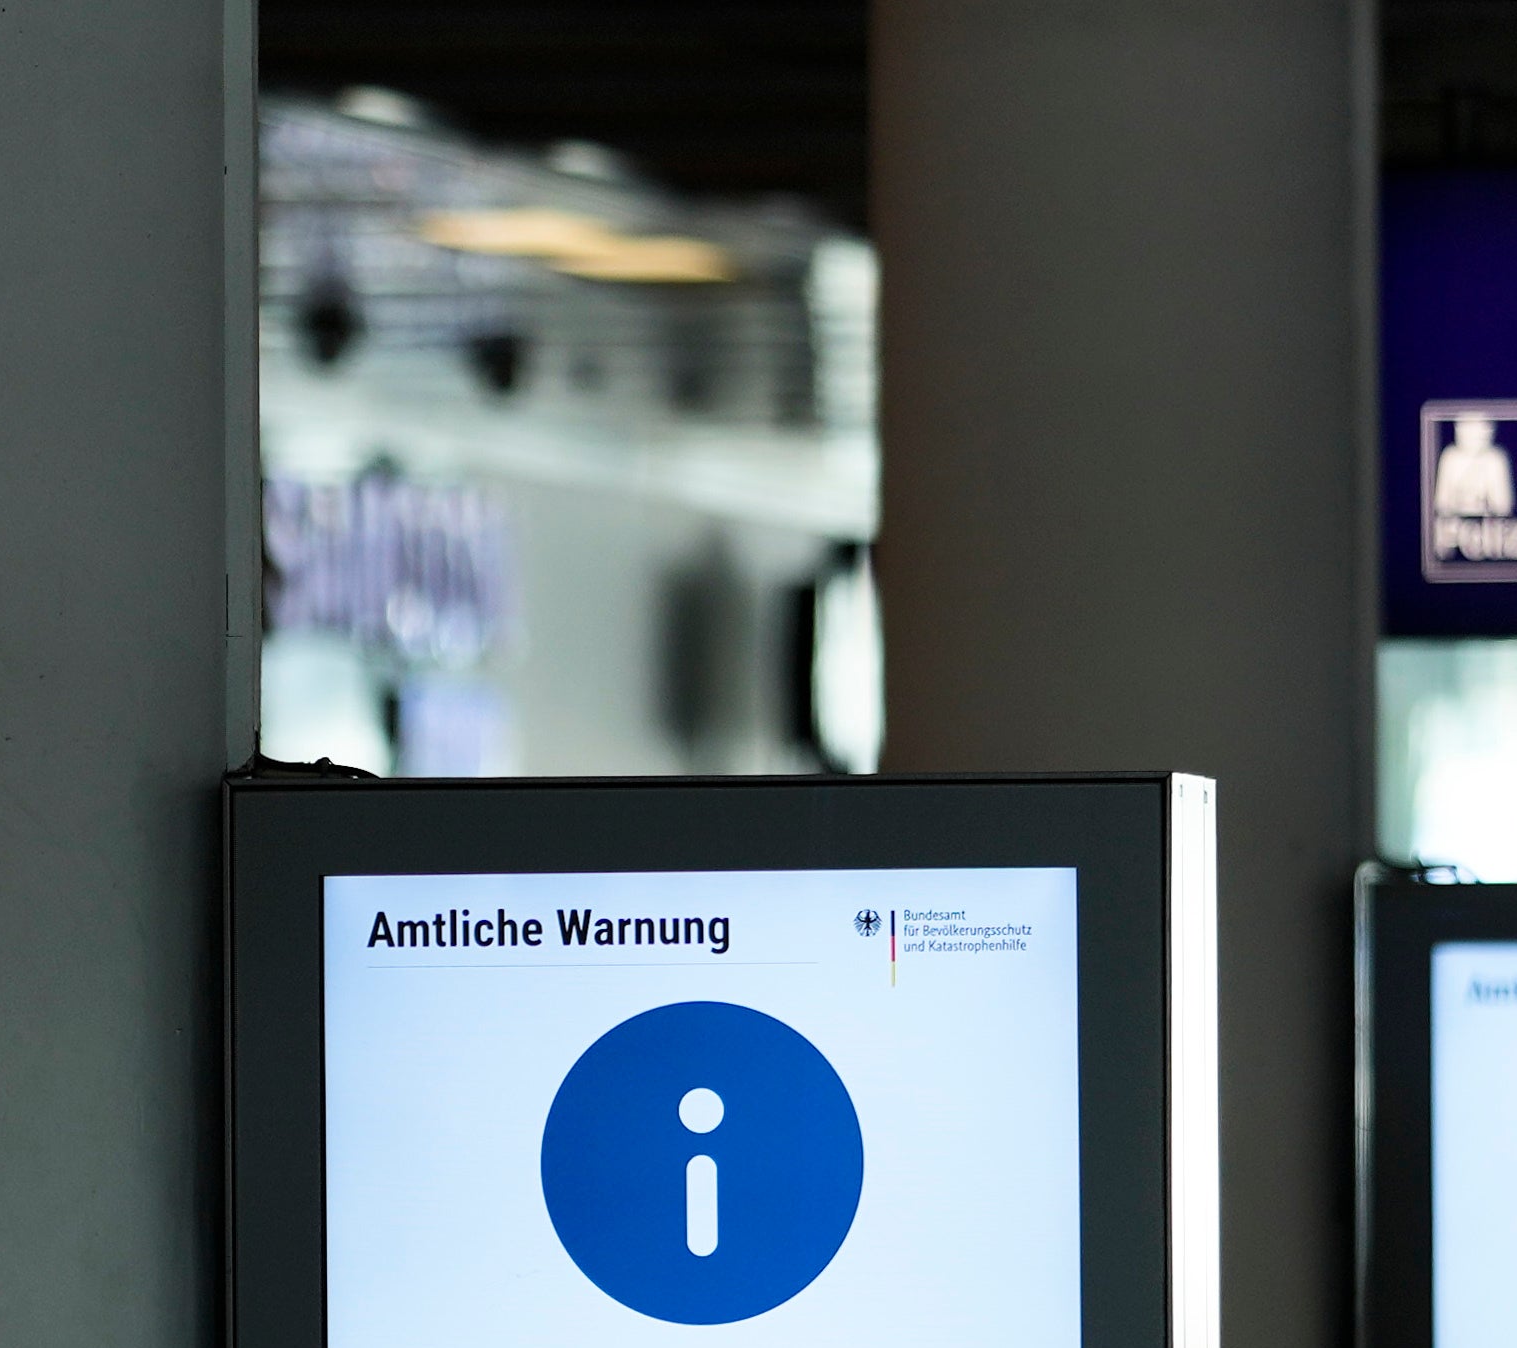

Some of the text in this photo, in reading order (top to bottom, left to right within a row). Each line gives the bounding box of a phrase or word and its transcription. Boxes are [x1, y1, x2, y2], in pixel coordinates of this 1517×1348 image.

[903, 909, 966, 922] Bundesamt
[366, 908, 731, 955] Amtliche Warnung
[903, 923, 1033, 938] für Bevölkerungsschutz
[903, 939, 1028, 954] und Katastrophenhilfe
